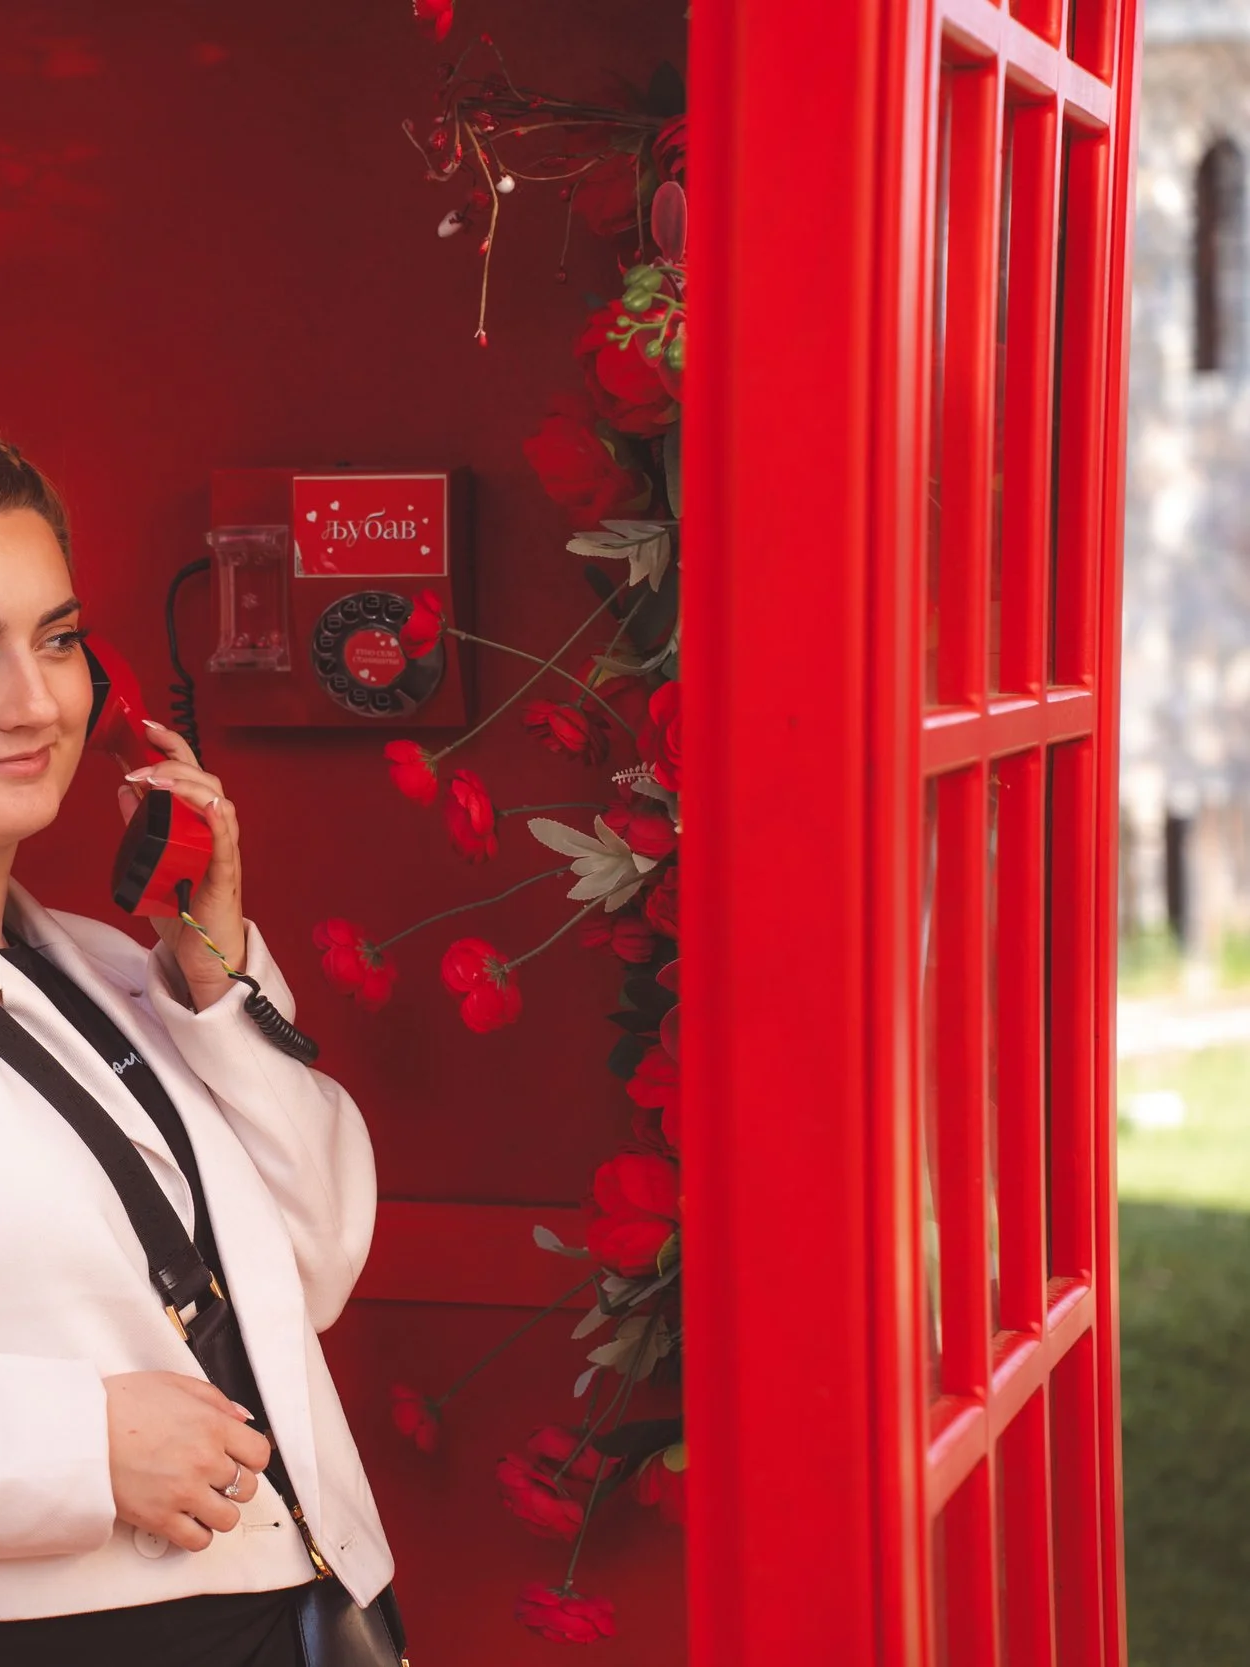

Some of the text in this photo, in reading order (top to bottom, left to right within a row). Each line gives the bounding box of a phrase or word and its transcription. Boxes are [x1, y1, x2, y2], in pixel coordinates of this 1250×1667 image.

[321, 507, 417, 548] љубав
[343, 600, 358, 612] 4
[365, 595, 380, 608] 3
[389, 599, 404, 612] 2
[327, 614, 342, 628] 5
[320, 634, 334, 647] 6
[321, 656, 336, 671] 7
[334, 675, 349, 688] 8
[353, 689, 367, 702] 9
